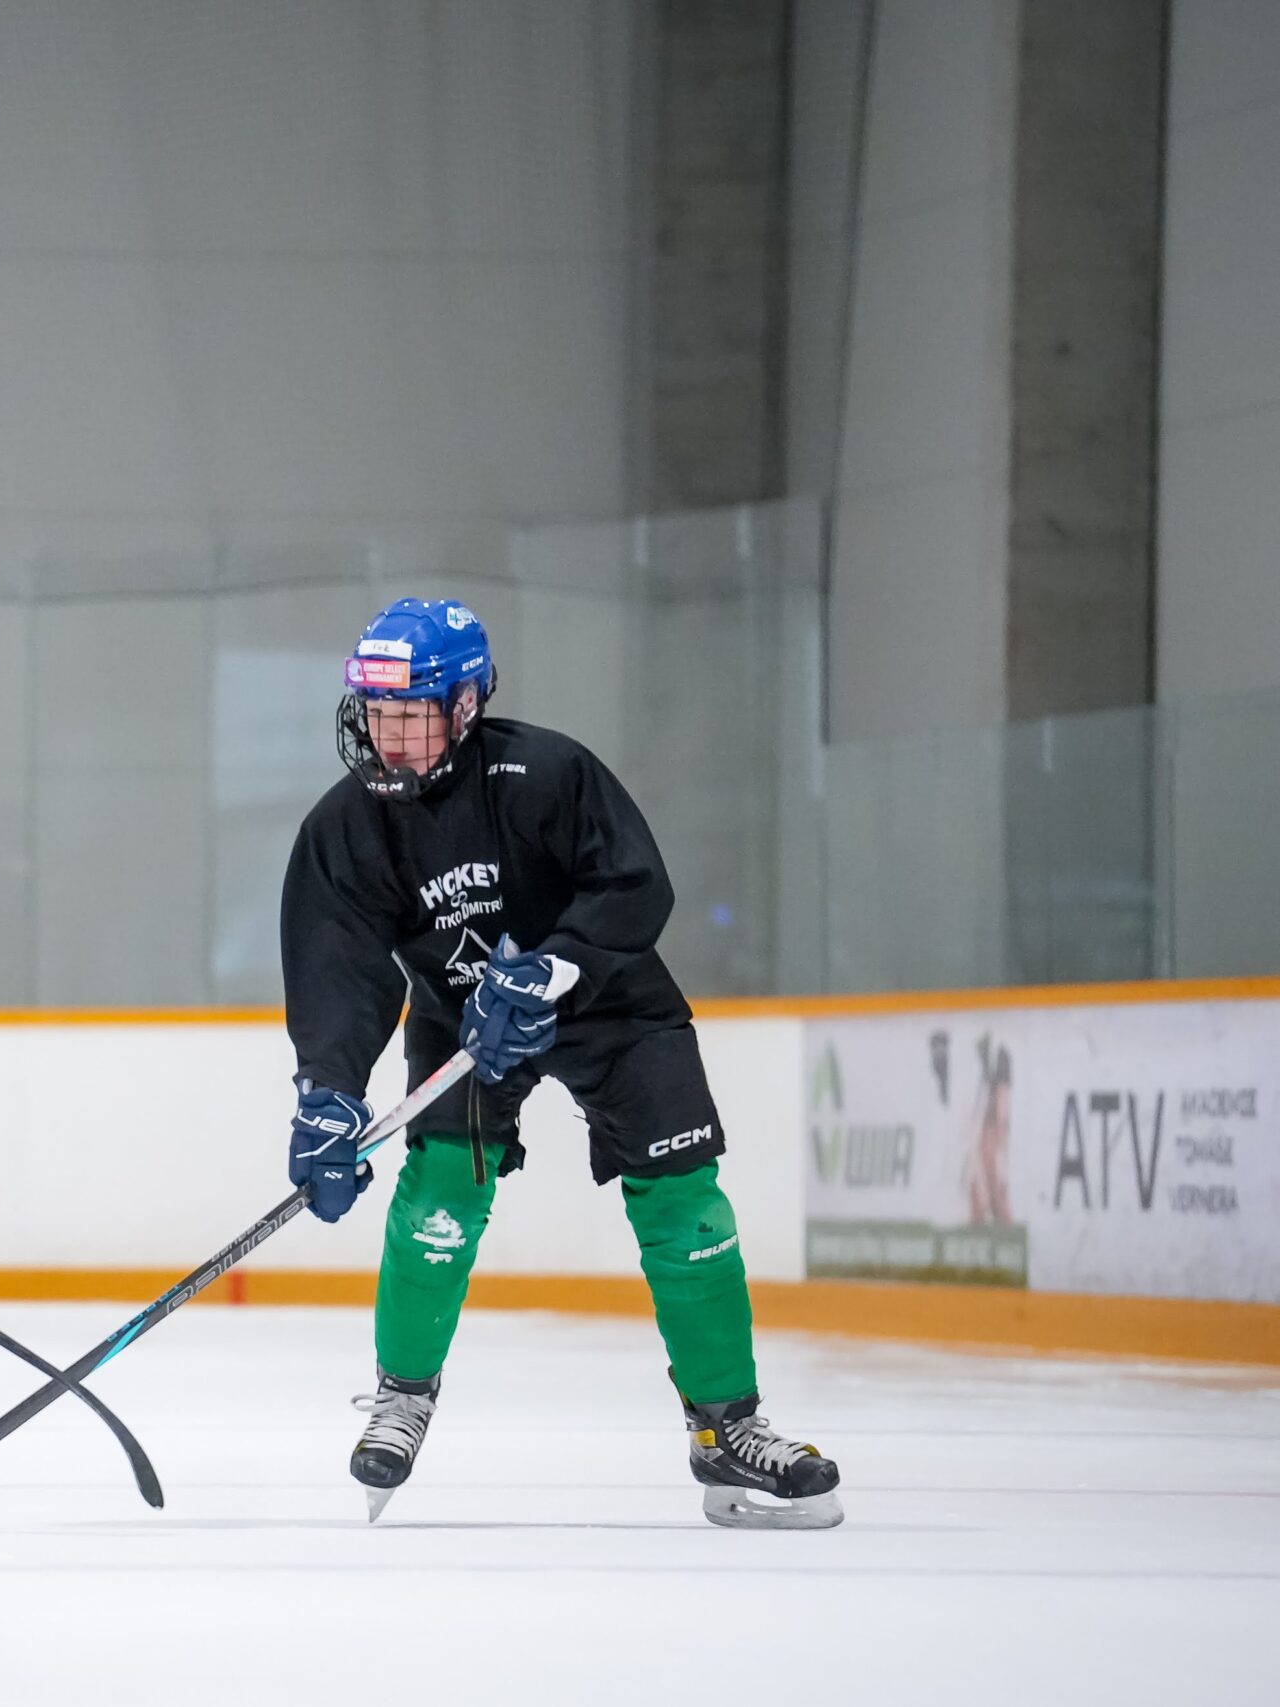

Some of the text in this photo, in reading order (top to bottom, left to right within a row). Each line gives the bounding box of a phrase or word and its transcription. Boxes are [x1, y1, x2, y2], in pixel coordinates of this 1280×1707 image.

[419, 862, 500, 911] HCKEY
[648, 1124, 712, 1158] CCM
[1053, 1089, 1166, 1211] ATV
